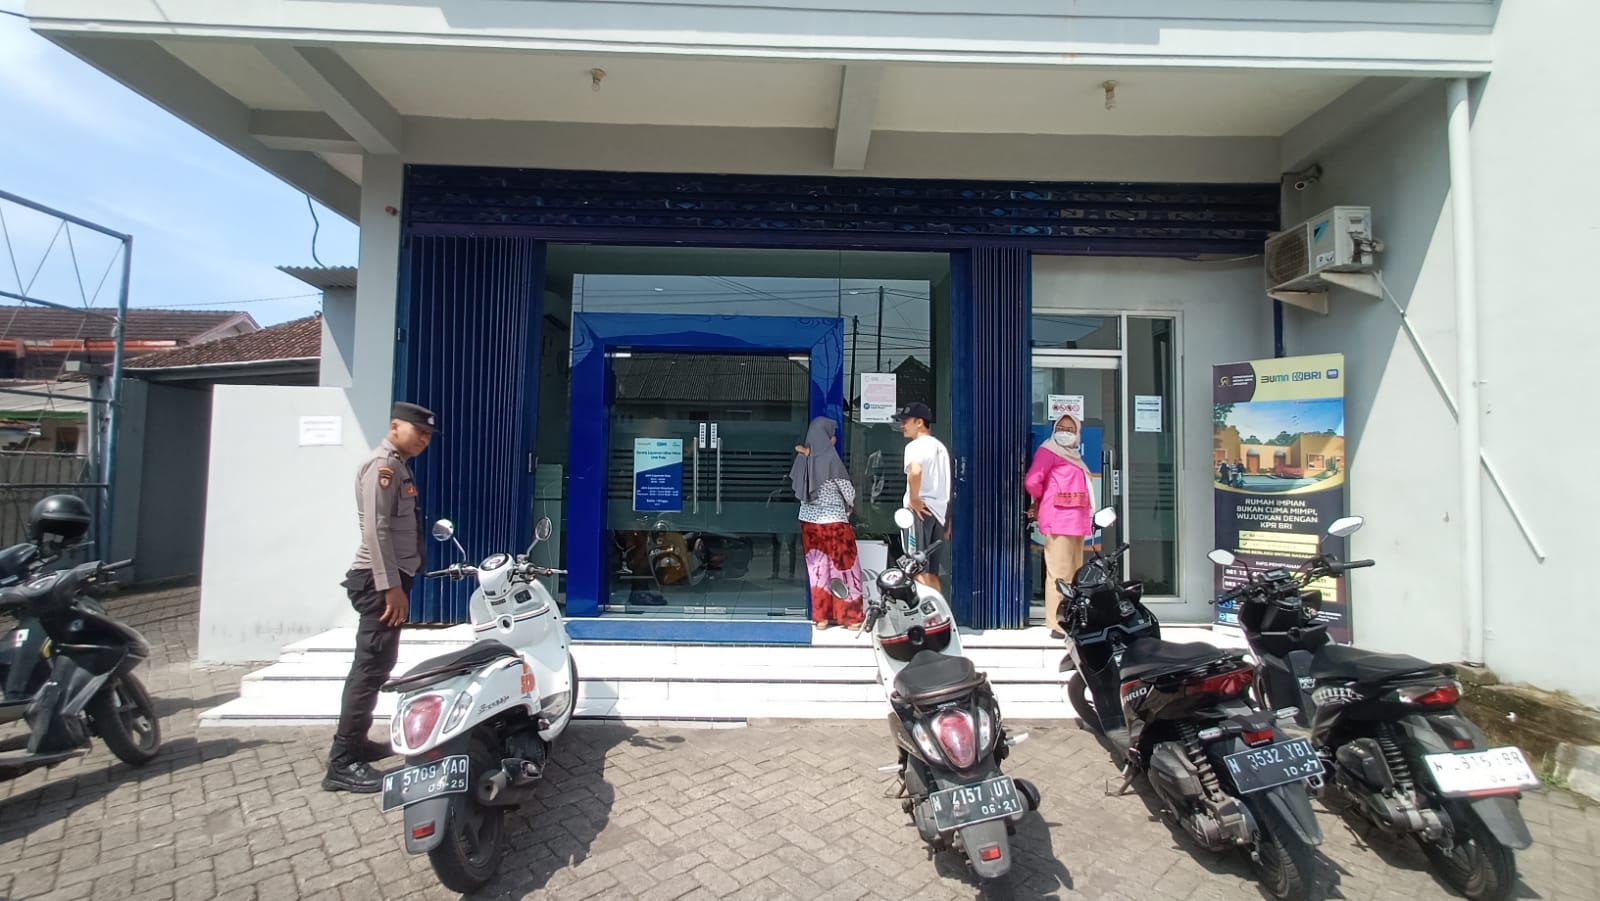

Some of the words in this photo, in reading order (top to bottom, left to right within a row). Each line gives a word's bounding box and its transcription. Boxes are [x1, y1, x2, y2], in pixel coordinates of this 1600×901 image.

[1245, 498, 1274, 506] RUMAH
[1236, 505, 1263, 513] BUKAN
[1265, 506, 1288, 514] CUMA
[1236, 513, 1281, 521] WUJUDKAN
[1283, 514, 1318, 523] DENGAN
[1260, 521, 1277, 529] KPR
[1278, 522, 1293, 530] BRI
[1247, 748, 1283, 769] 3532
[385, 776, 393, 792] N
[403, 765, 436, 786] 5709
[932, 796, 942, 812] N
[952, 786, 982, 806] 4157
[993, 779, 1010, 797] UT
